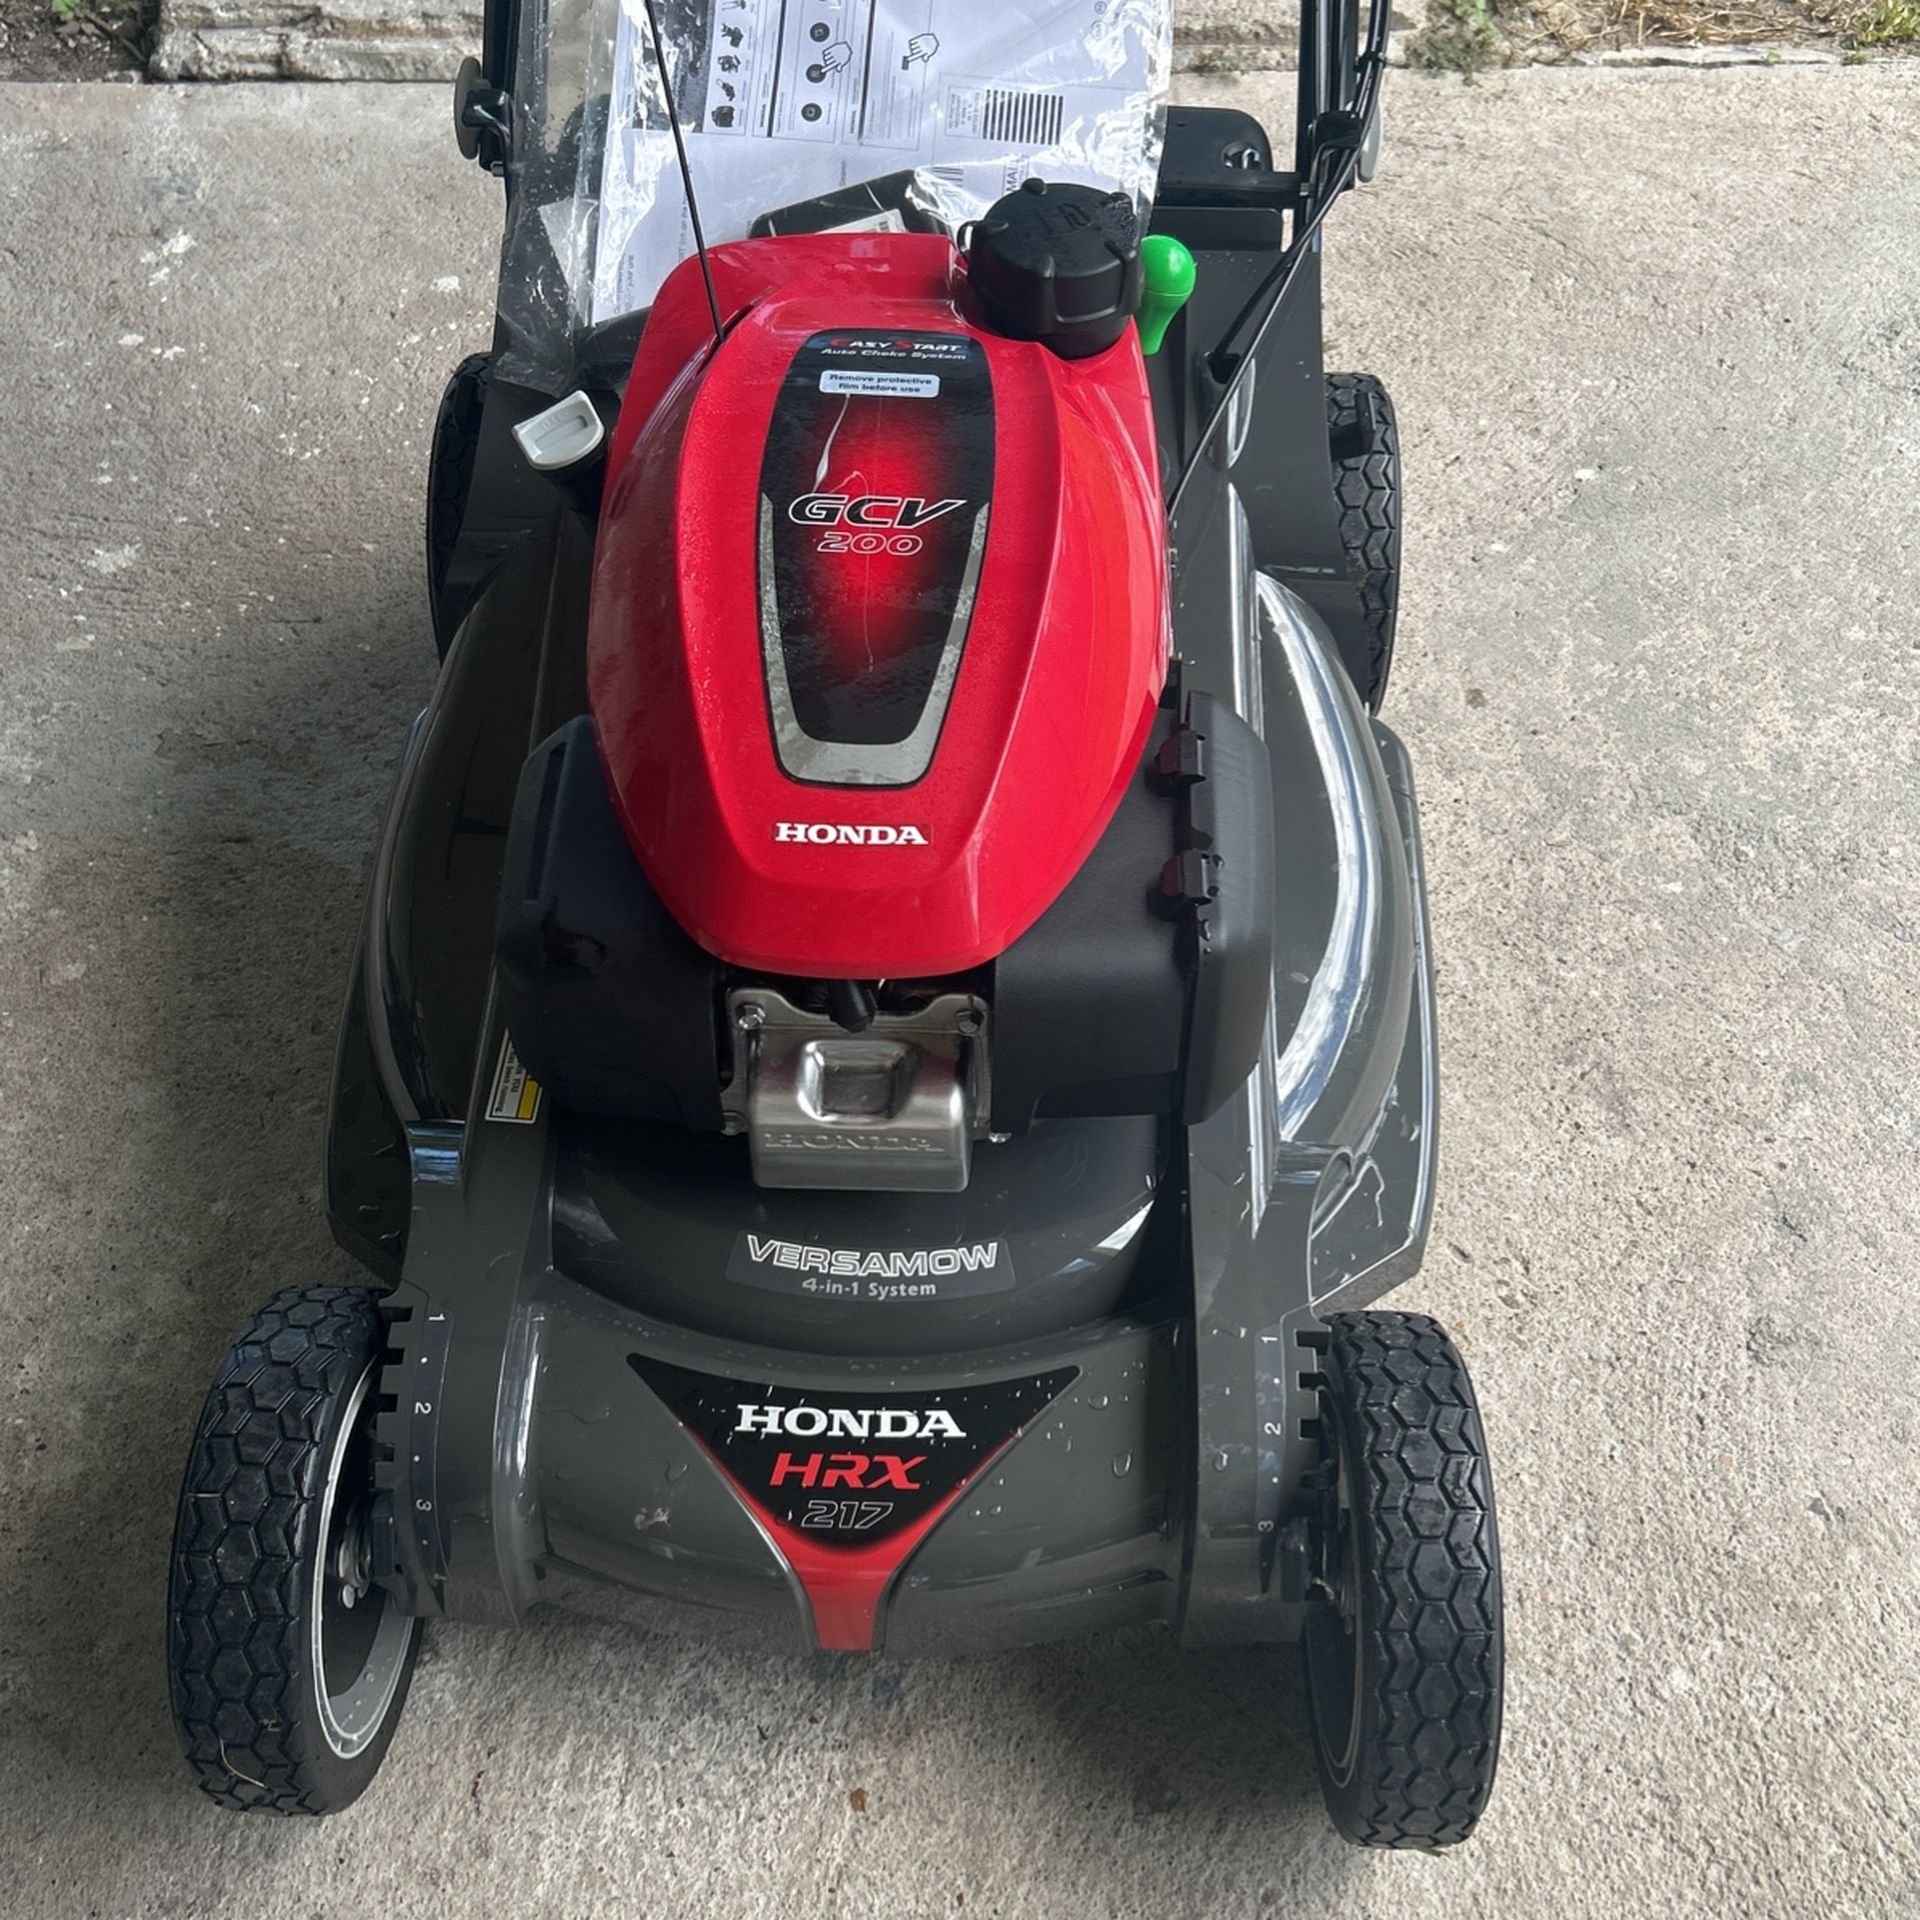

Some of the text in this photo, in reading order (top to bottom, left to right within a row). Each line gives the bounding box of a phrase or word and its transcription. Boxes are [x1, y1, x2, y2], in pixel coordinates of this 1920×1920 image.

[821, 348, 966, 360] Auto Choke System
[830, 374, 932, 387] Remove protective
[838, 383, 859, 391] film
[862, 383, 897, 392] before
[788, 493, 967, 529] GCV
[817, 531, 923, 556] 200
[775, 823, 928, 845] HONDA
[765, 1132, 944, 1152] HONDA
[747, 1234, 998, 1277] VERSAMOW
[802, 1277, 936, 1299] 4-in-1 System
[428, 1313, 445, 1321] 1
[415, 1402, 431, 1414] 2
[734, 1404, 966, 1438] HONDA
[1264, 1423, 1281, 1435] 2
[770, 1452, 928, 1490] HRX
[416, 1499, 432, 1511] 3
[802, 1500, 893, 1529] 217
[1258, 1521, 1274, 1532] 3
